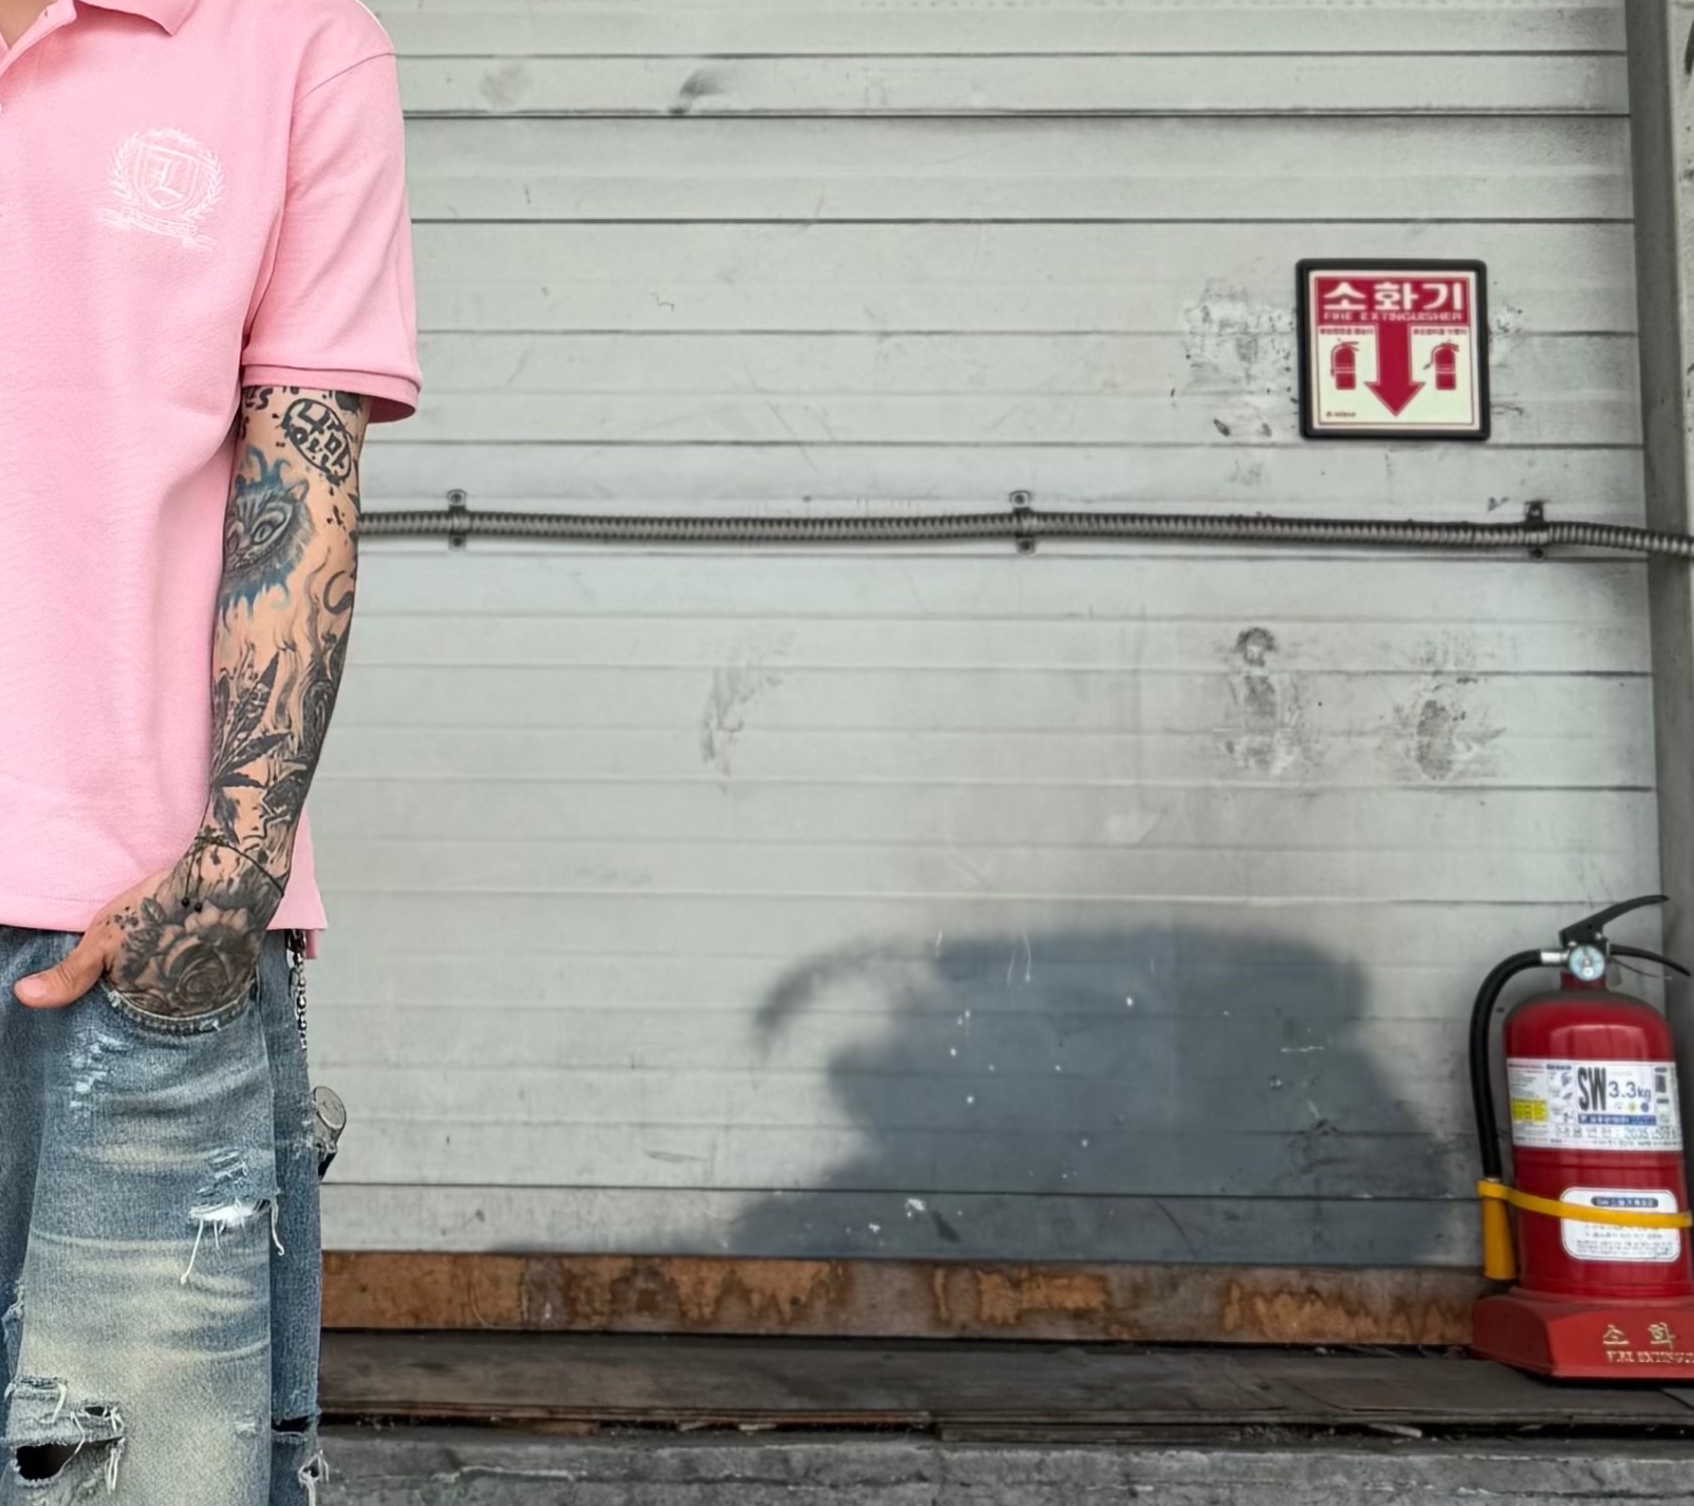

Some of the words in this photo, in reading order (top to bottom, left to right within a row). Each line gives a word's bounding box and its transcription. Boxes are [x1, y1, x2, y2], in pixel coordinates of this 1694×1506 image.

[1323, 281, 1463, 311] 소화기
[1323, 312, 1352, 321] FIRE
[1360, 312, 1462, 322] EXTINGUISHER
[1577, 1067, 1607, 1111] SW
